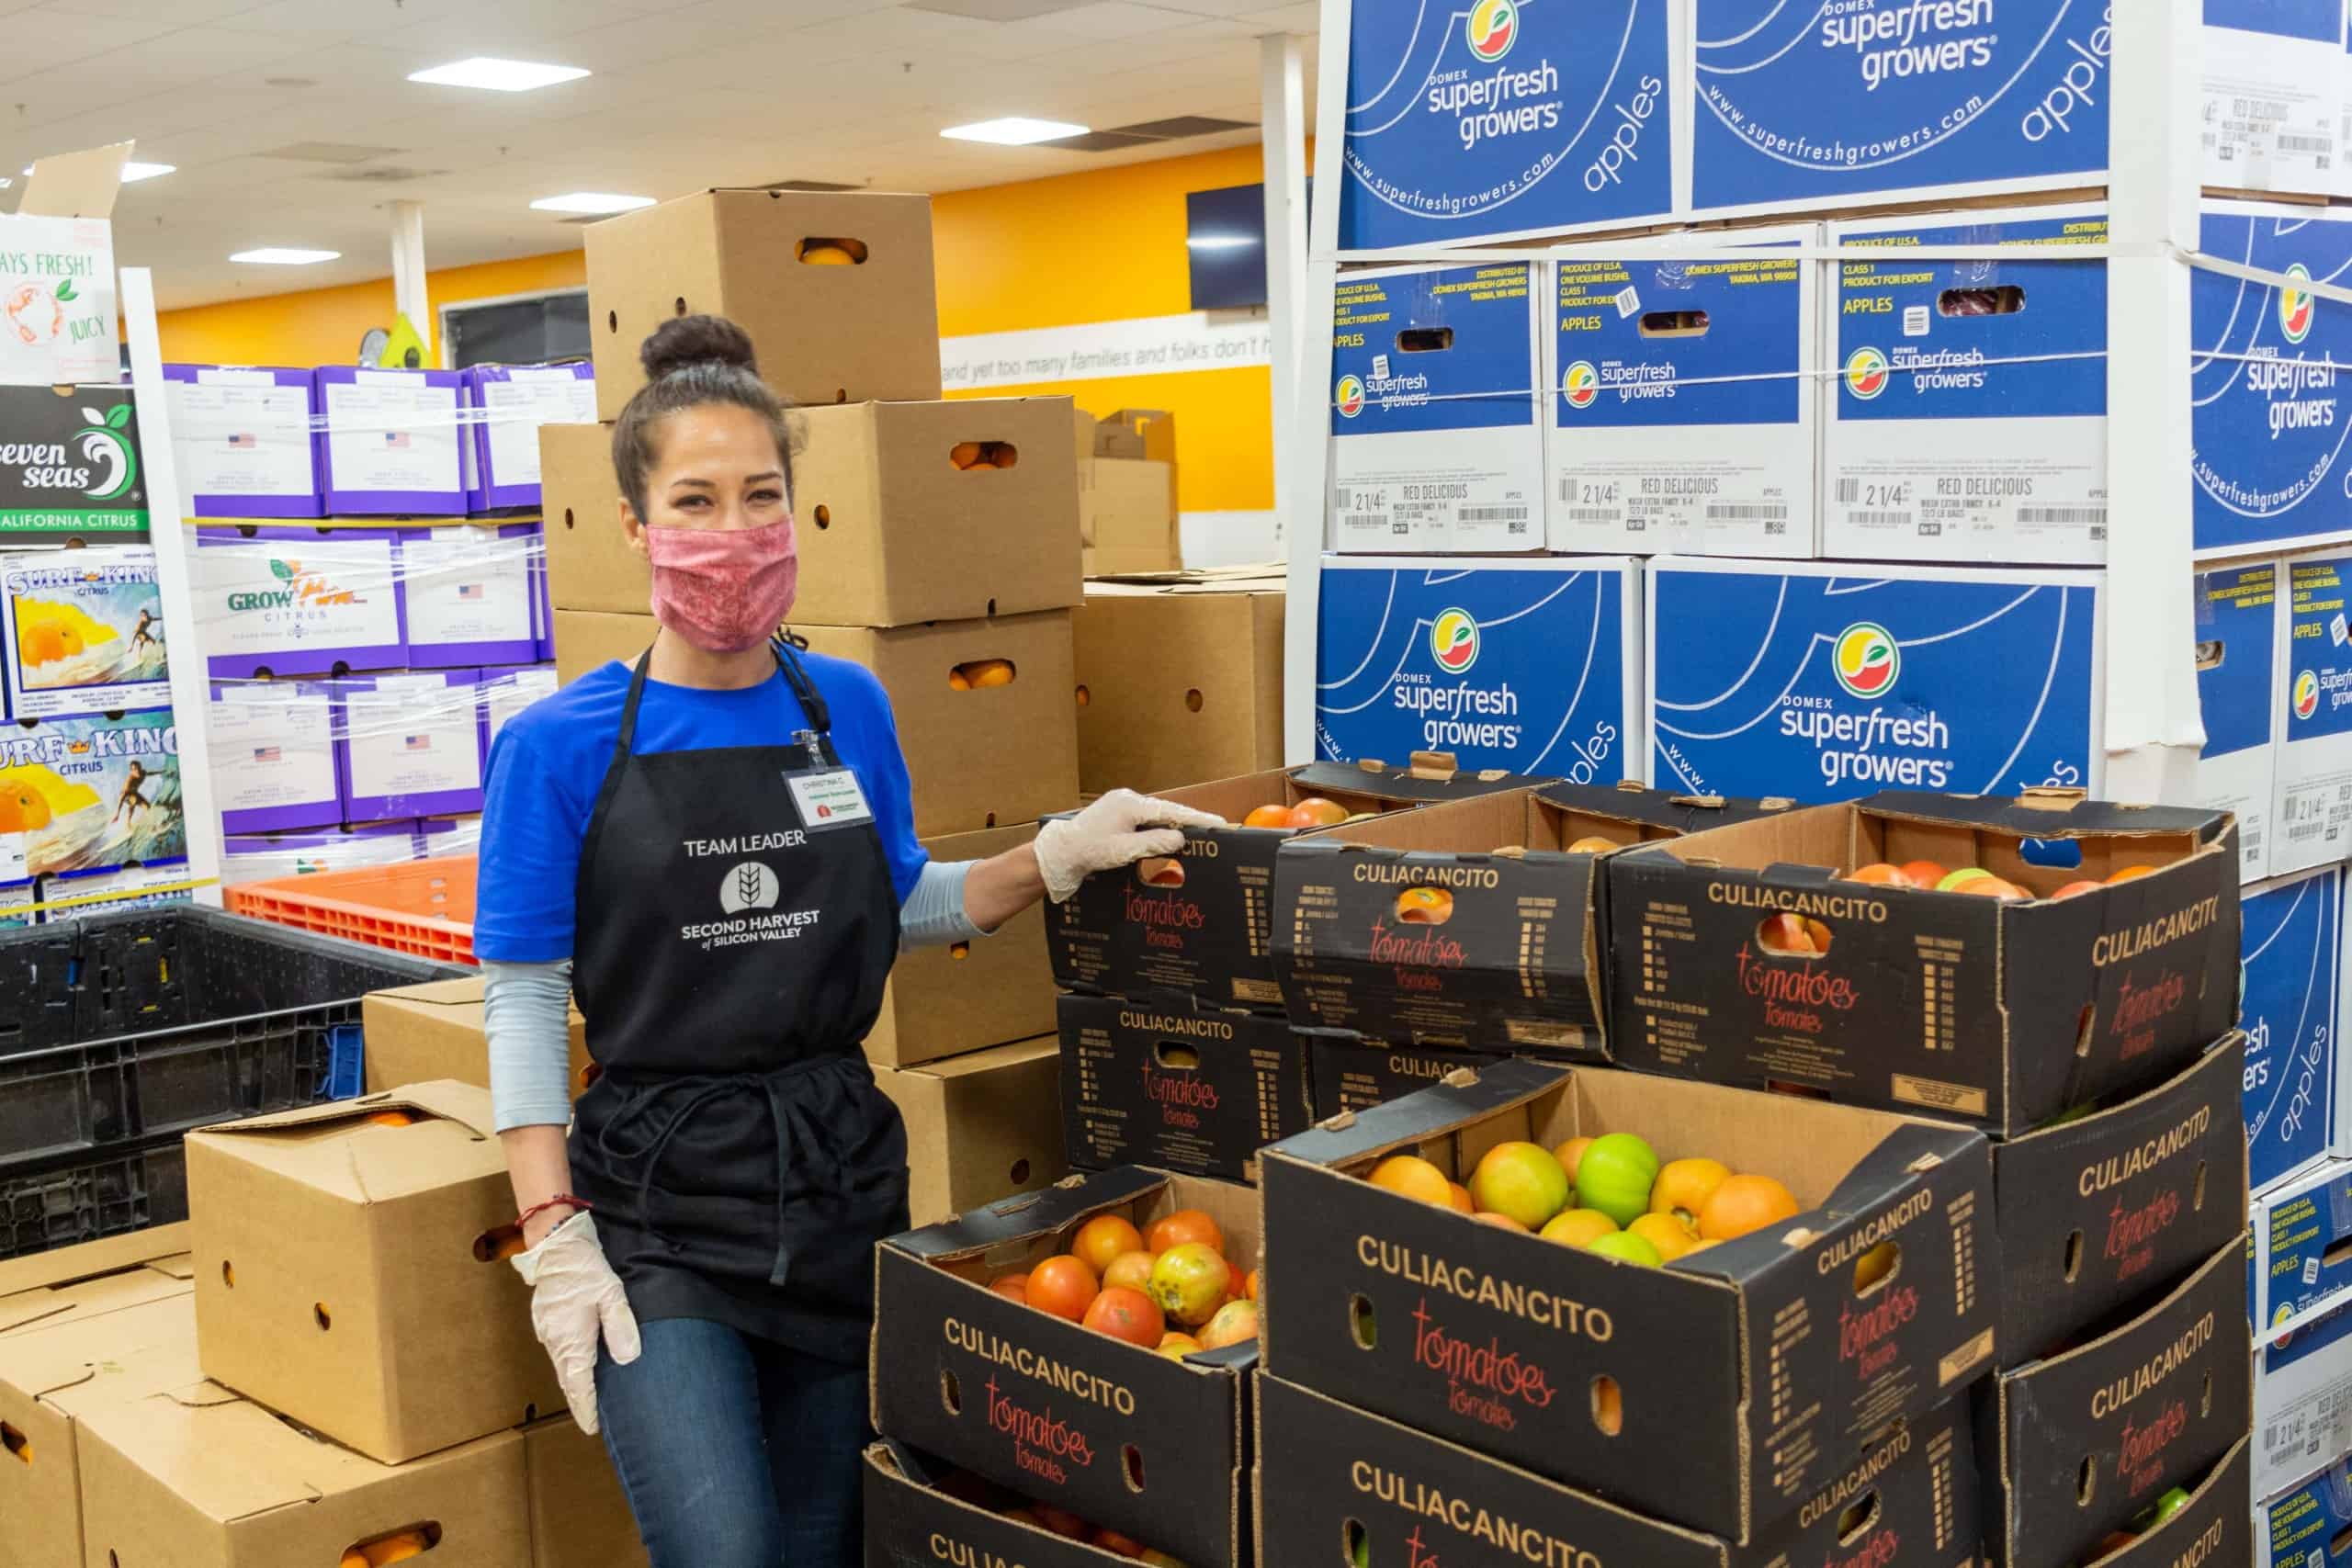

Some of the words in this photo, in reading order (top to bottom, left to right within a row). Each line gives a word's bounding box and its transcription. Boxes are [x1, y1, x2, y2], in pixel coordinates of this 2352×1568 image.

[1822, 0, 1992, 52] superfresh
[1861, 35, 1991, 91] growers
[1428, 59, 1558, 118] superfresh
[1429, 69, 1468, 86] DOMEX
[1460, 103, 1559, 150] growers
[1584, 74, 1662, 192] apples
[1710, 85, 1983, 165] www.superfreshgrowers.com
[36, 254, 93, 276] FRESH!
[1844, 265, 1869, 275] CLASS
[1844, 276, 1883, 287] PRODUCT
[1844, 297, 1893, 314] APPLES
[70, 316, 106, 344] JUICY
[1561, 316, 1601, 331] APPLES
[943, 365, 967, 381] and
[972, 363, 995, 382] yet
[997, 360, 1022, 377] too
[1025, 356, 1067, 377] many
[1070, 350, 1131, 369] families
[1136, 345, 1167, 365] and
[1171, 341, 1207, 360] folks
[1215, 336, 1256, 358] don't
[1892, 347, 1984, 374] superfresh
[1366, 373, 1428, 395] superfresh
[1601, 362, 1676, 384] superfresh
[1914, 370, 1984, 394] growers
[2247, 351, 2335, 400] superfresh
[1619, 384, 1676, 403] growers
[2269, 399, 2335, 439] growers
[0, 443, 66, 466] even
[23, 467, 90, 489] seas
[1403, 485, 1419, 500] RED
[1422, 483, 1468, 500] DELICIOUS
[1641, 478, 1660, 494] RED
[1664, 478, 1718, 494] DELICIOUS
[1938, 478, 1962, 495] RED
[1966, 478, 2032, 495] DELICIOUS
[1866, 486, 1874, 505] 2
[87, 514, 137, 527] CITRUS
[6, 567, 83, 597] SURF
[76, 587, 109, 596] CITRUS
[228, 590, 294, 610] GROW
[265, 611, 327, 623] CITRUS
[2293, 622, 2323, 639] APPLES
[1395, 673, 1431, 684] DOMEX
[1395, 682, 1517, 719] superfresh
[1782, 695, 1833, 709] DOMEX
[1424, 719, 1518, 750] growers
[1781, 707, 1948, 750] superfresh
[1566, 720, 1616, 785] ples
[60, 761, 103, 775] CITRUS
[1821, 749, 1947, 787] growers
[684, 837, 737, 857] TEAM
[741, 829, 807, 852] LEADER
[1353, 863, 1499, 888] CULIACANCITO
[1708, 882, 1886, 923] CULIACANCITO
[682, 919, 746, 940] SECOND
[750, 910, 820, 930] HARVEST
[702, 938, 712, 951] of
[714, 931, 758, 947] SILICON
[760, 927, 801, 941] VALLEY
[1120, 1012, 1233, 1040] CULIACANCITO
[1389, 1056, 1455, 1081] CULIAC
[2280, 1023, 2327, 1142] apples
[2079, 1105, 2210, 1197] CULIACANCITO
[1818, 1189, 1931, 1275] CULIACANCITO
[2271, 1254, 2299, 1278] APPLES
[1357, 1235, 1612, 1341] CULIACANCITO
[945, 1317, 1136, 1416] CULIACANCITO
[2092, 1312, 2213, 1418] CULIACANCITO
[1800, 1430, 1911, 1529] CULIACANCITO
[930, 1533, 1025, 1568] CULI
